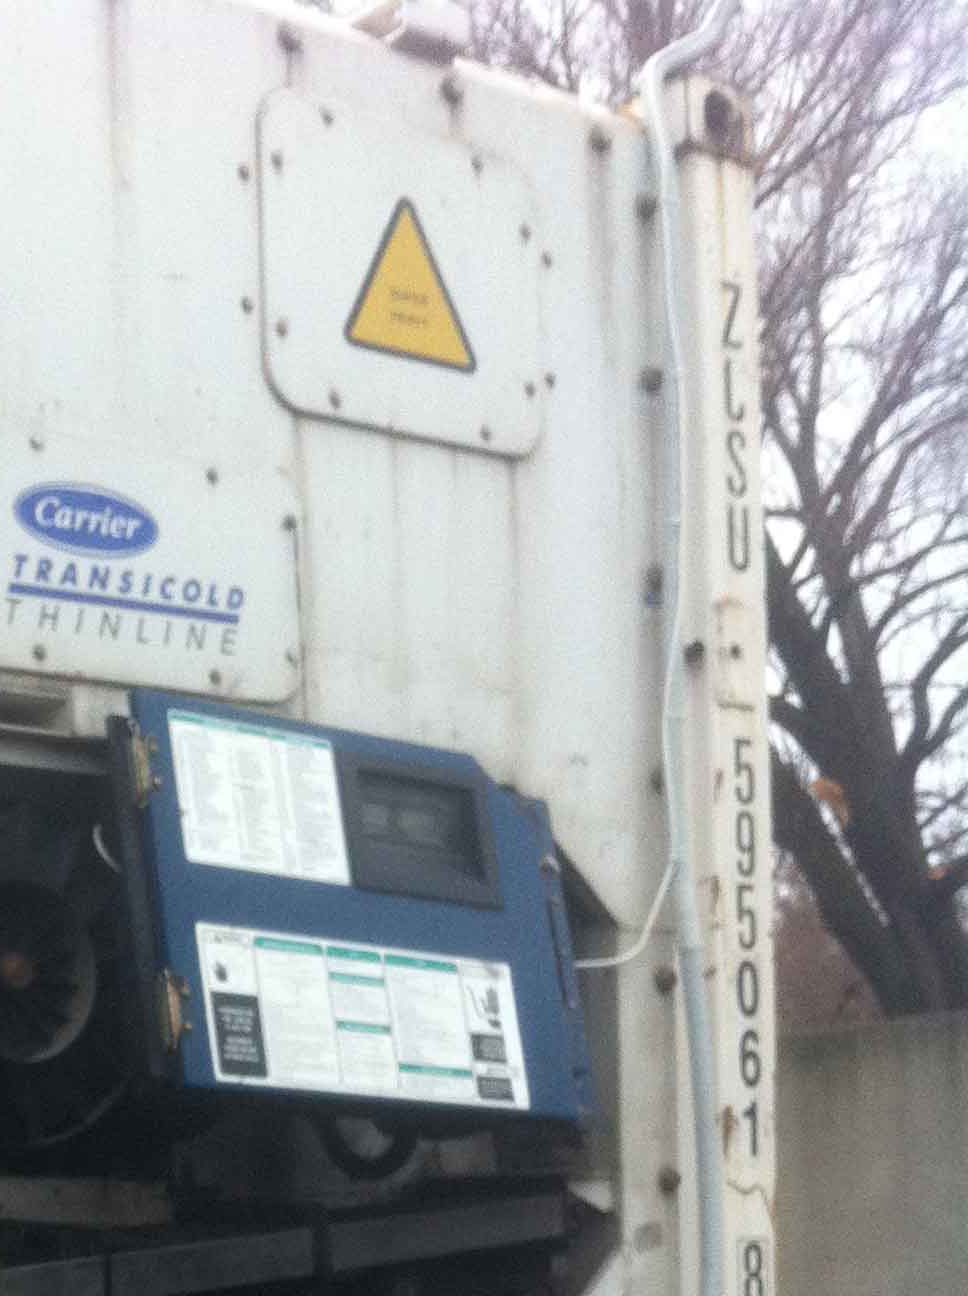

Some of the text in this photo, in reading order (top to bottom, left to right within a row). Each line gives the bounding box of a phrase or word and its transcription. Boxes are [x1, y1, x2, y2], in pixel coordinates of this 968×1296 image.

[34, 495, 142, 540] Carrier
[12, 554, 245, 610] TRANSICOLD
[5, 598, 239, 656] THINLINE
[733, 737, 762, 1158] 595061
